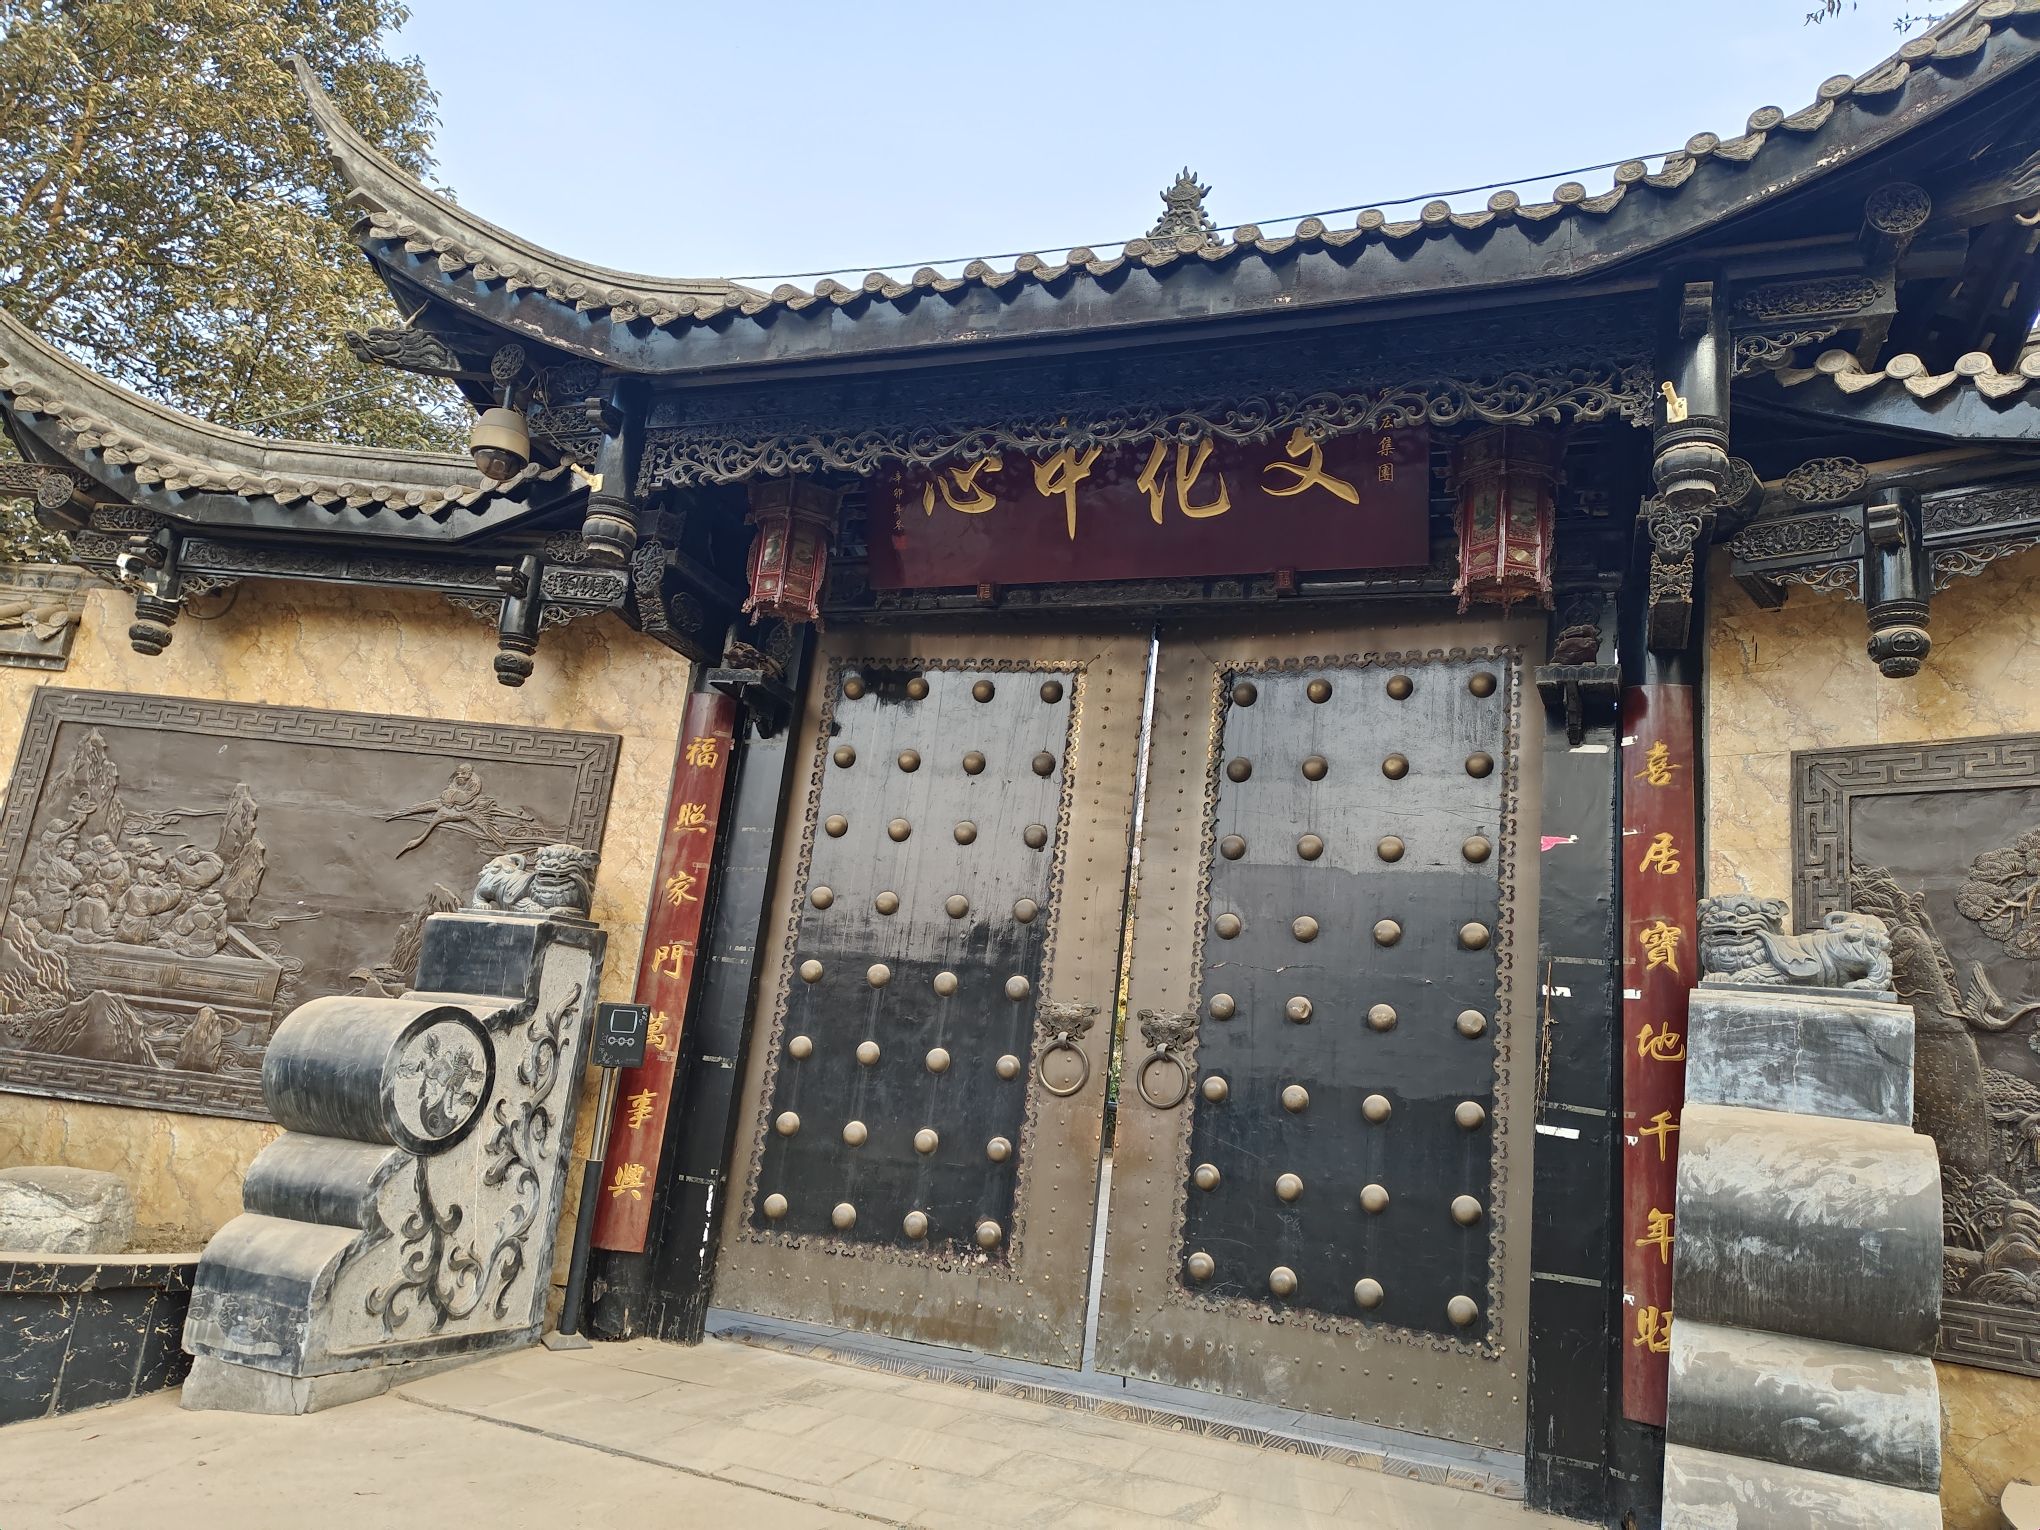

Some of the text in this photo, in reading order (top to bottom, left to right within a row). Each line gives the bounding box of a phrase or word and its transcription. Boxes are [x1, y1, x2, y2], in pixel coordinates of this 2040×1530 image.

[923, 418, 1360, 541] 文化中心
[607, 735, 720, 1202] 福照家門萬事興
